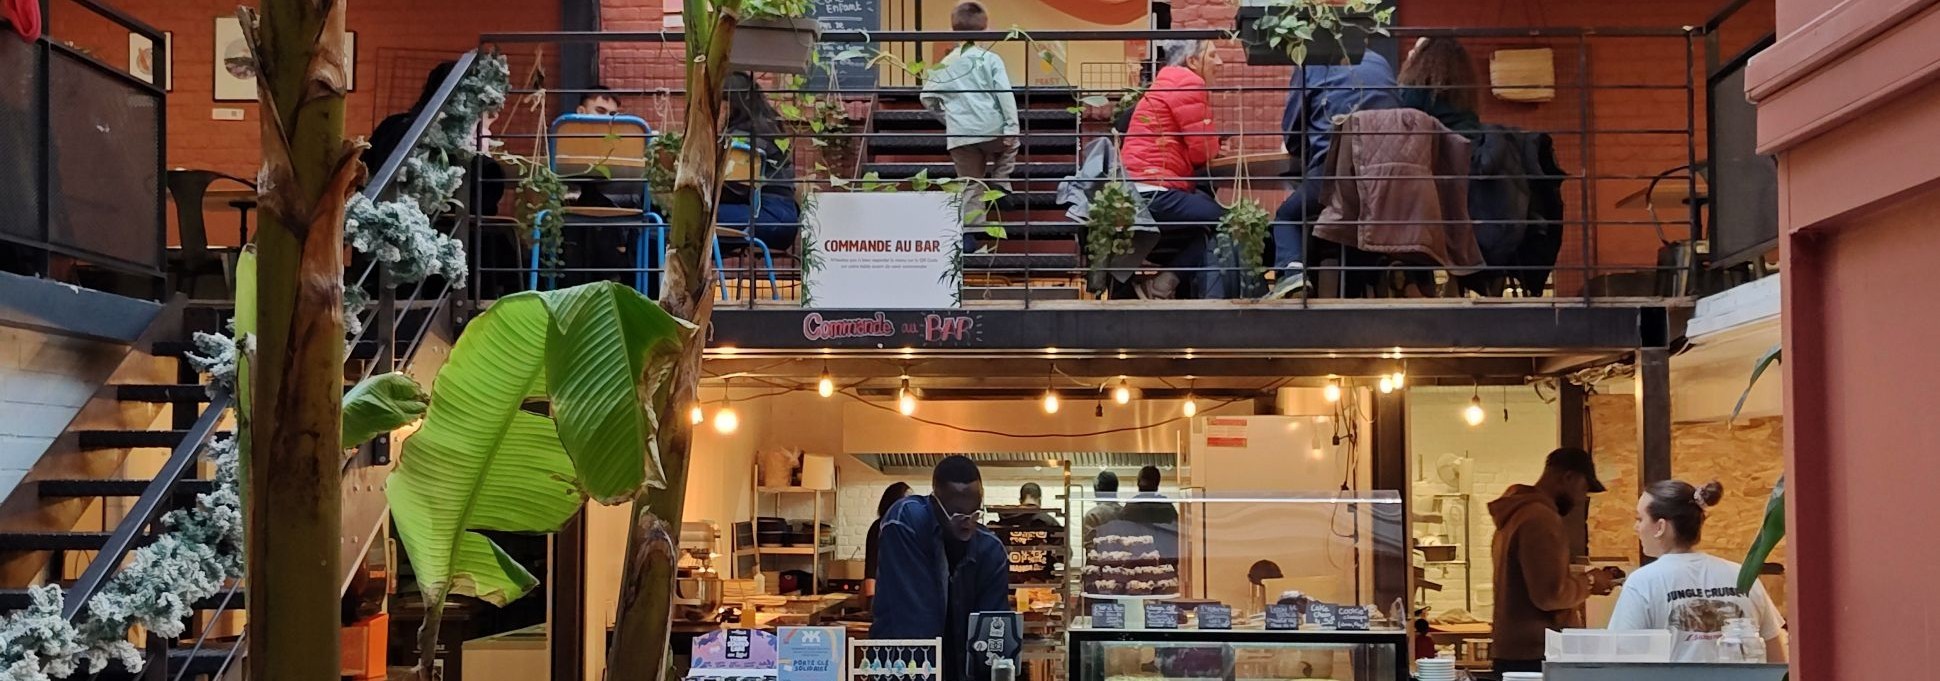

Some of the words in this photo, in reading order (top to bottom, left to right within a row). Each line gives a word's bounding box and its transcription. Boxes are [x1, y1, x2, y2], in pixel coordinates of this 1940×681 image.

[825, 240, 892, 252] COMMANDE
[895, 240, 912, 252] AU
[915, 240, 940, 252] BAR
[803, 311, 895, 341] Commande
[902, 323, 918, 333] au
[924, 314, 973, 342] BAR
[1667, 588, 1703, 603] JUNGLE
